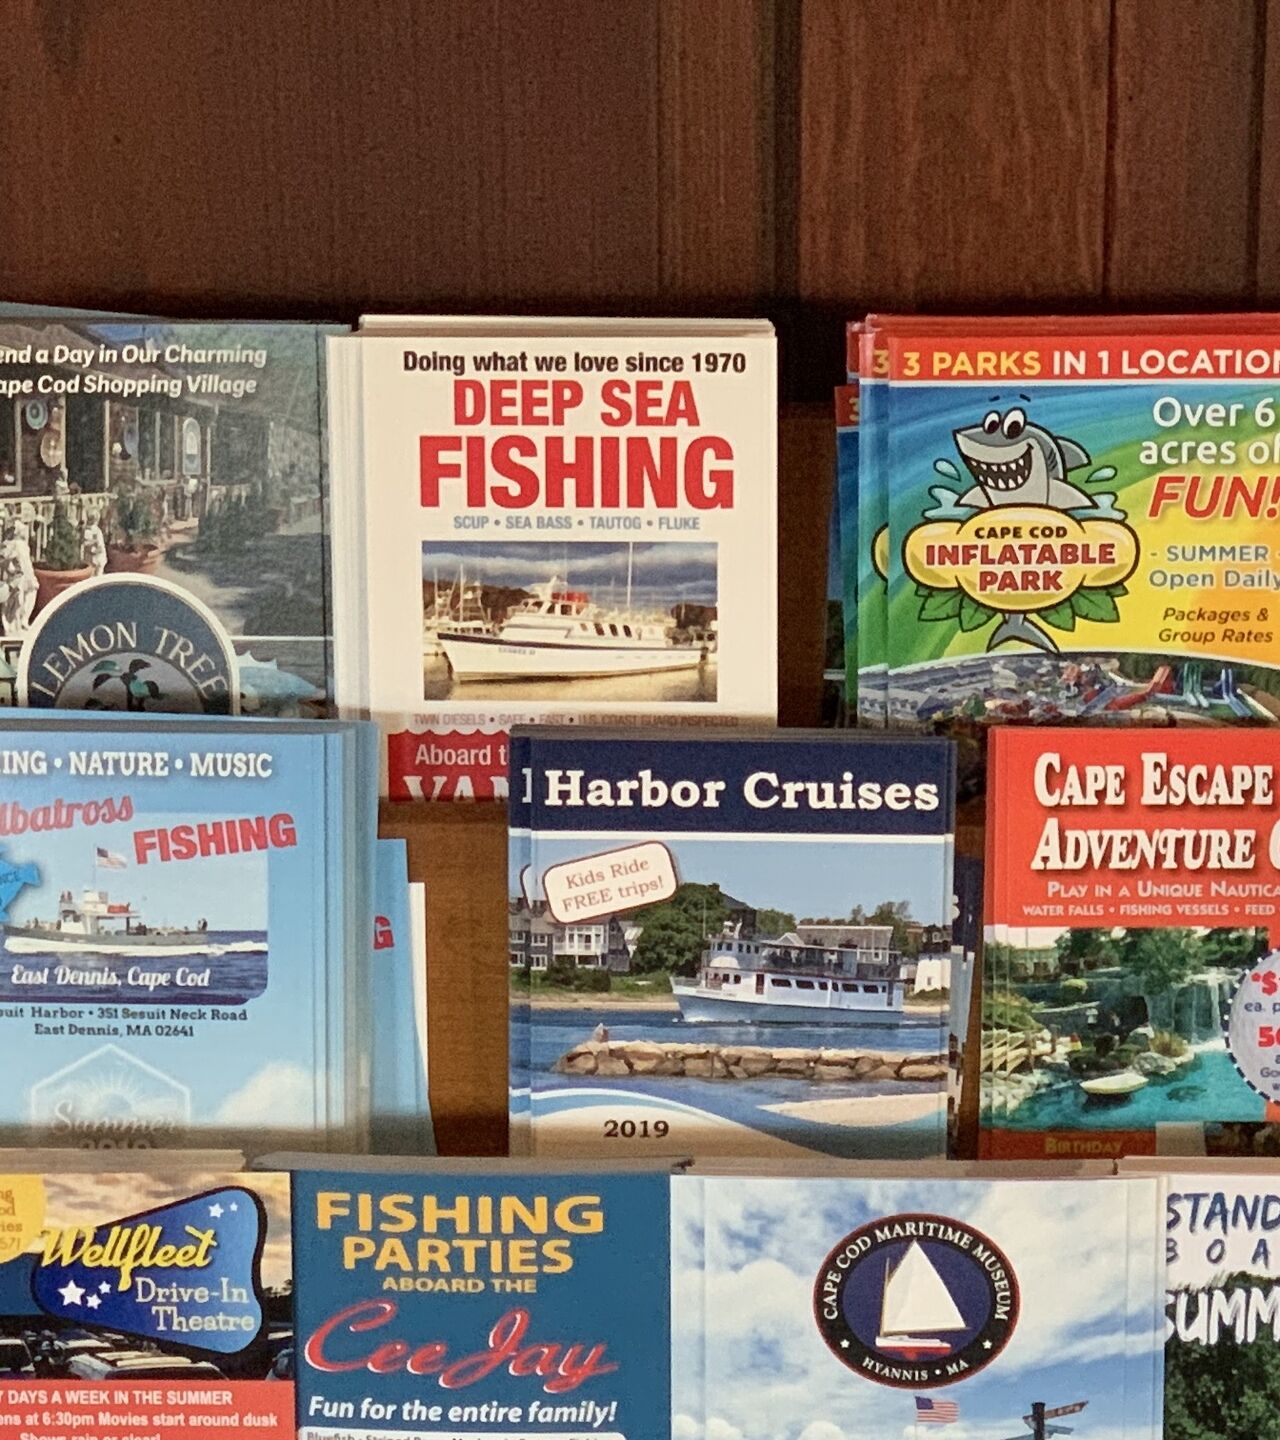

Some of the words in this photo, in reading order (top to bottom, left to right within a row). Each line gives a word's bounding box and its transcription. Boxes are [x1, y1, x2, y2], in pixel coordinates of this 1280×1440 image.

[35, 350, 49, 364] a
[53, 346, 94, 367] Day
[98, 345, 118, 364] in
[122, 346, 161, 364] Our
[164, 346, 267, 368] Charming
[903, 353, 920, 375] 3
[932, 352, 1042, 375] PARKS
[1053, 351, 1086, 375] IN
[1099, 352, 1110, 374] 1
[454, 380, 584, 426] DEEP
[600, 380, 699, 426] SEA
[420, 435, 734, 510] FISHING
[454, 517, 489, 530] SCUP
[505, 517, 534, 529] SEA
[537, 517, 572, 530] BASS
[589, 517, 641, 530] TAUTOG
[659, 517, 700, 530] FLUKE
[975, 526, 1023, 539] CAPE
[1029, 526, 1068, 539] COD
[926, 543, 1116, 566] INFLATABLE
[980, 571, 1063, 591] PARK
[32, 622, 137, 700] LEMON
[155, 627, 228, 700] TREE
[69, 752, 169, 776] NATURE
[190, 753, 272, 777] MUSIC
[1034, 752, 1125, 807] CAPE
[544, 769, 726, 808] Harbor
[744, 772, 939, 811] Cruises
[133, 813, 297, 864] FISHING
[1030, 817, 1256, 870] ADVENTURE
[603, 1120, 669, 1138] 2019
[316, 1192, 604, 1234] FISHING
[38, 1224, 217, 1291] Wellfleet
[343, 1237, 574, 1273] PARTIES
[823, 1269, 842, 1320] CAPE
[835, 1237, 872, 1267] COD
[874, 1221, 973, 1248] MARITIME
[972, 1242, 1011, 1321] MUSEUM
[135, 1277, 249, 1304] Drive-In
[151, 1306, 255, 1332] Theatre
[863, 1356, 928, 1381] HYANNIS
[946, 1360, 970, 1377] MA
